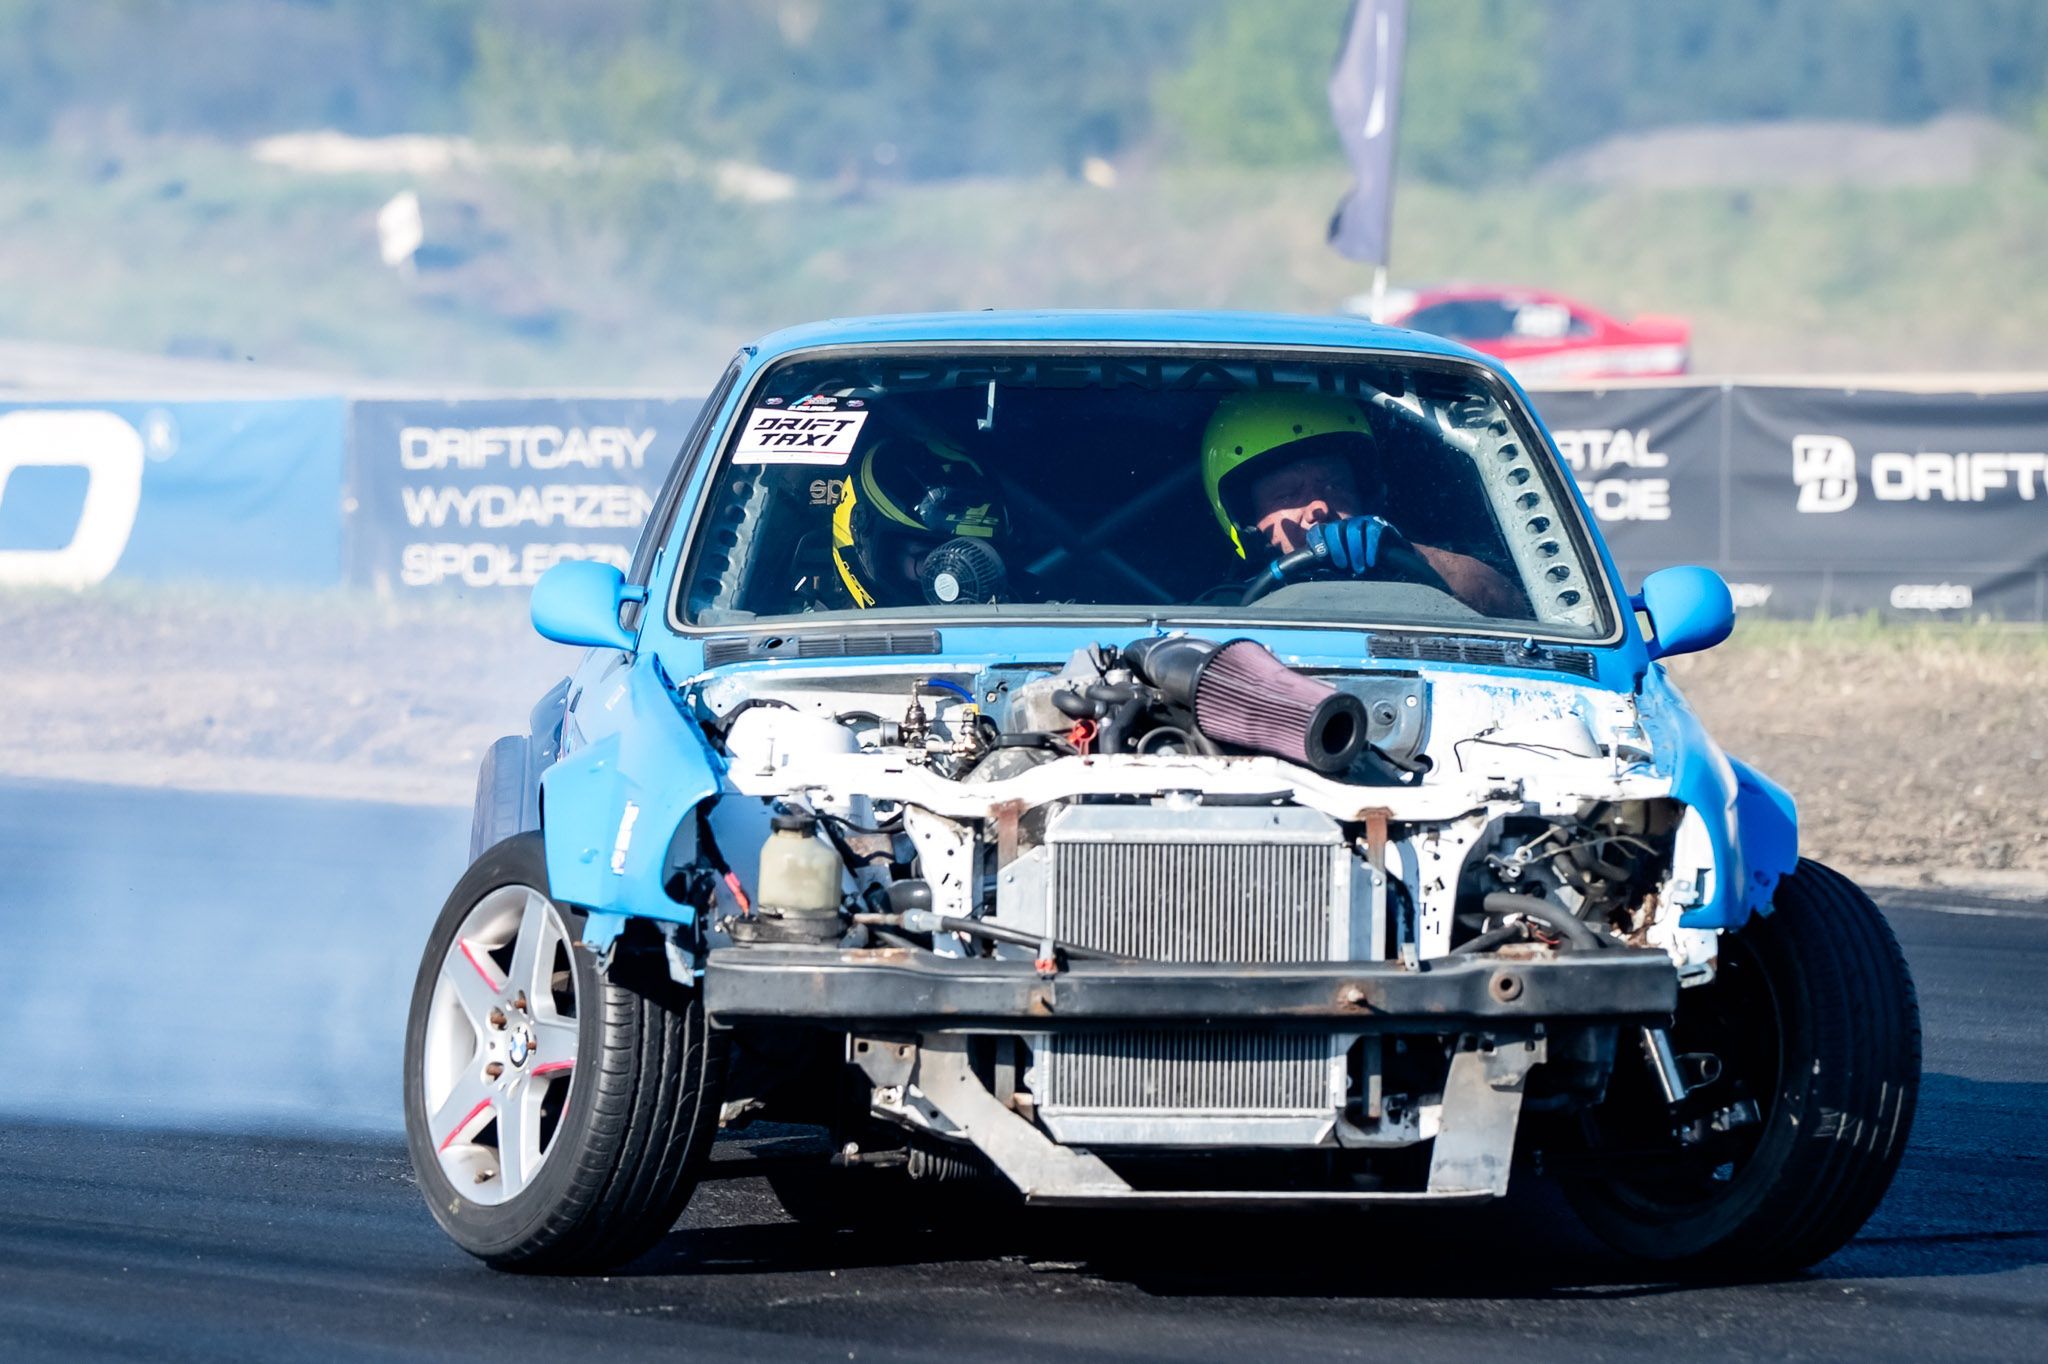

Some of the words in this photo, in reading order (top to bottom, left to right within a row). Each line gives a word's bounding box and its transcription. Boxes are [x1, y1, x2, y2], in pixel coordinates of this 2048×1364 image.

[753, 418, 856, 432] DRIFT
[401, 426, 657, 470] DRIFTCARY
[758, 433, 838, 447] TAXI
[1870, 452, 2048, 501] DRIFT
